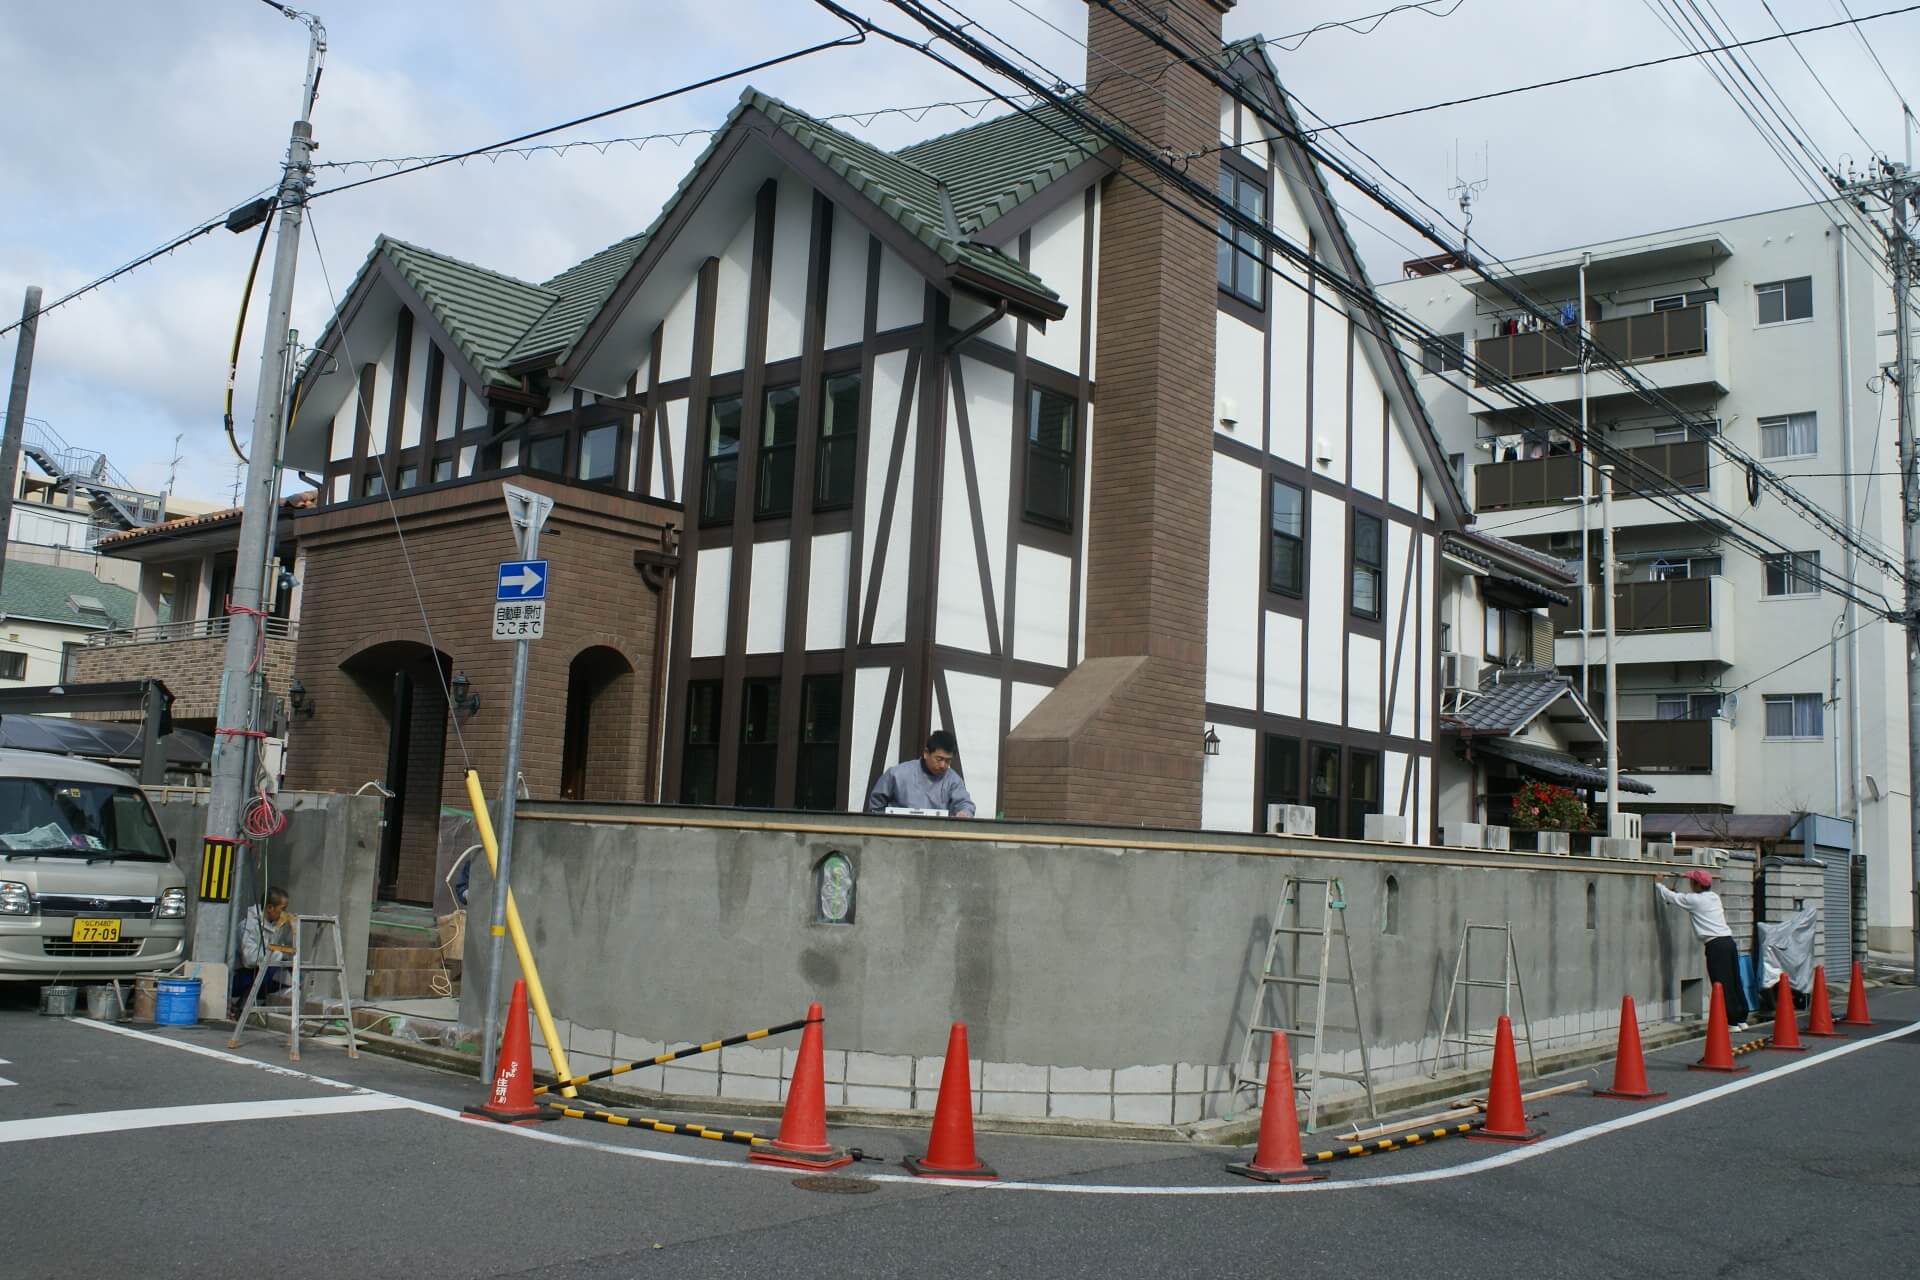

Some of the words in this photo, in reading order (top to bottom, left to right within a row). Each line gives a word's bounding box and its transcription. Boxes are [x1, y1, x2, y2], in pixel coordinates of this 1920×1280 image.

[496, 621, 541, 634] ここまで
[82, 928, 117, 940] 77-09
